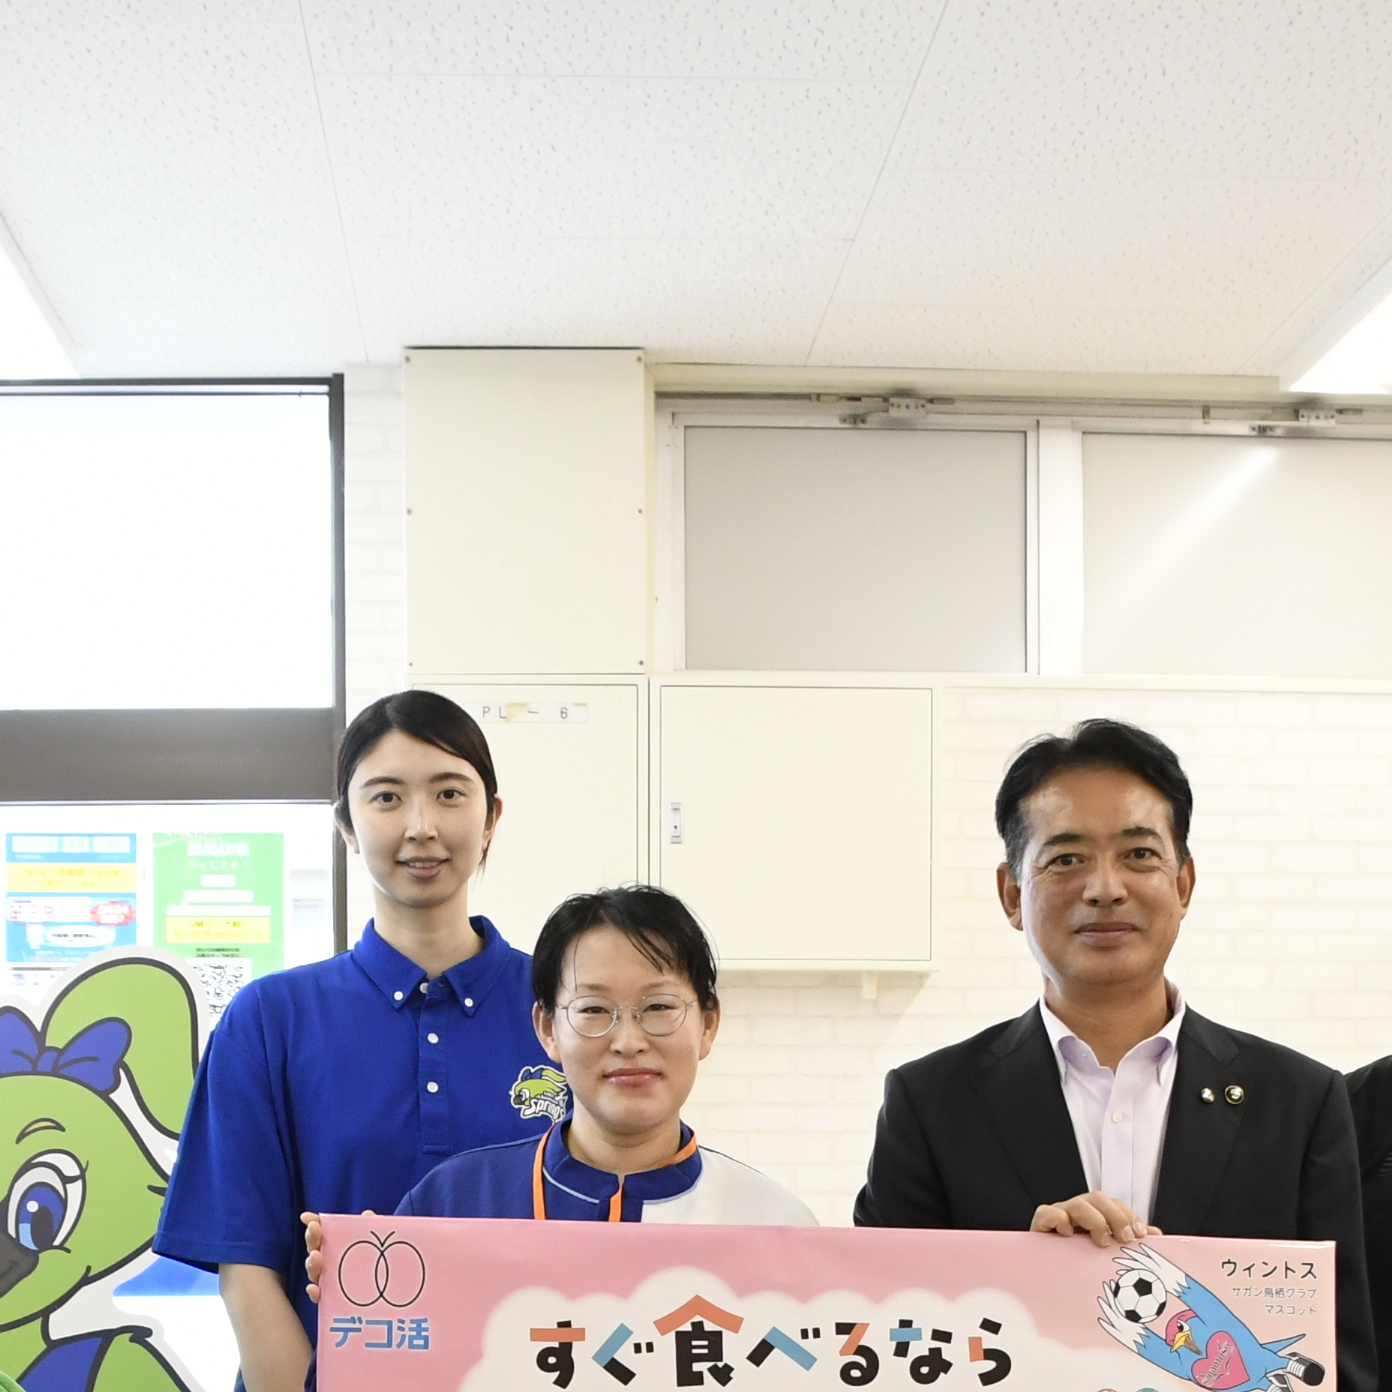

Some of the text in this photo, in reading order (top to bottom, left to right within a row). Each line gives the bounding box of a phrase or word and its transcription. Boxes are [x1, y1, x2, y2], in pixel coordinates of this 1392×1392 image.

[1221, 1258, 1317, 1279] ウィントス
[1232, 1286, 1317, 1299] サガン鳥栖クラブ
[1264, 1304, 1316, 1316] マスコット
[329, 1316, 429, 1350] デコ活
[530, 1296, 1012, 1389] すぐ食べるなら
